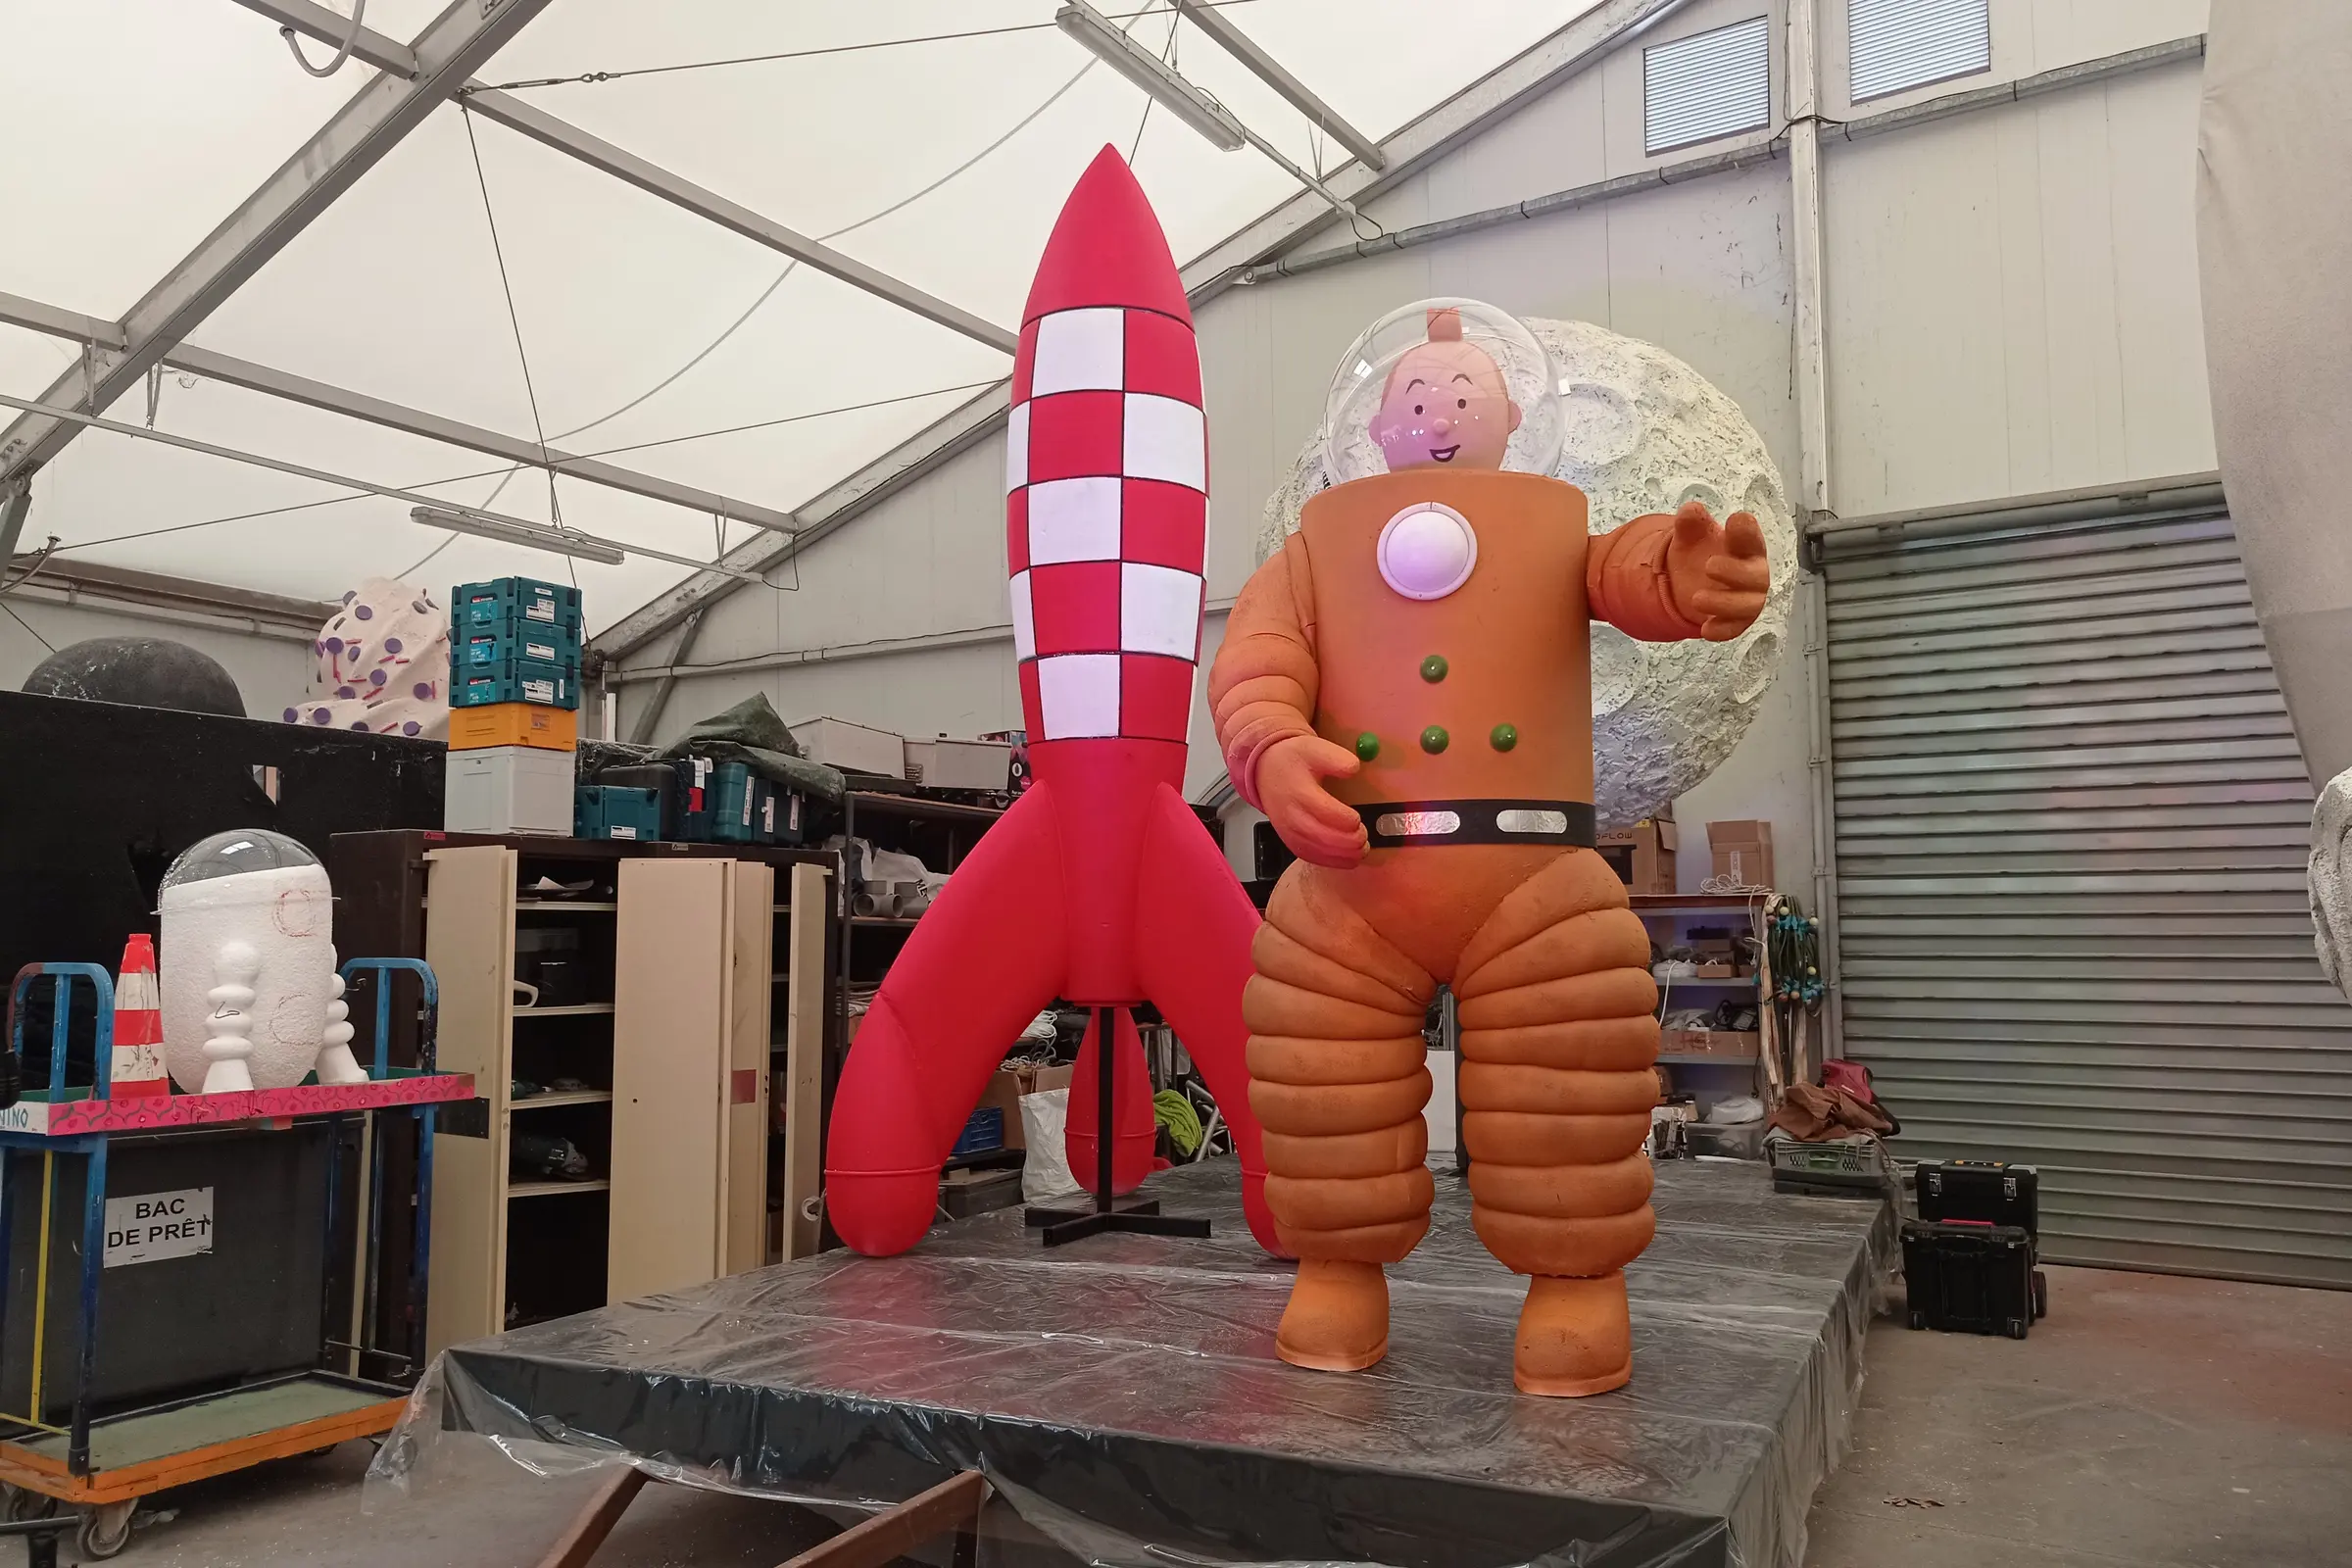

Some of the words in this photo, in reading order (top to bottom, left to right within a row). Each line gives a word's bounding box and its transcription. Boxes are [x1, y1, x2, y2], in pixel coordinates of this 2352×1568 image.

[135, 1198, 185, 1220] BAC
[108, 1228, 140, 1249] DE
[148, 1217, 209, 1243] PRÊT
